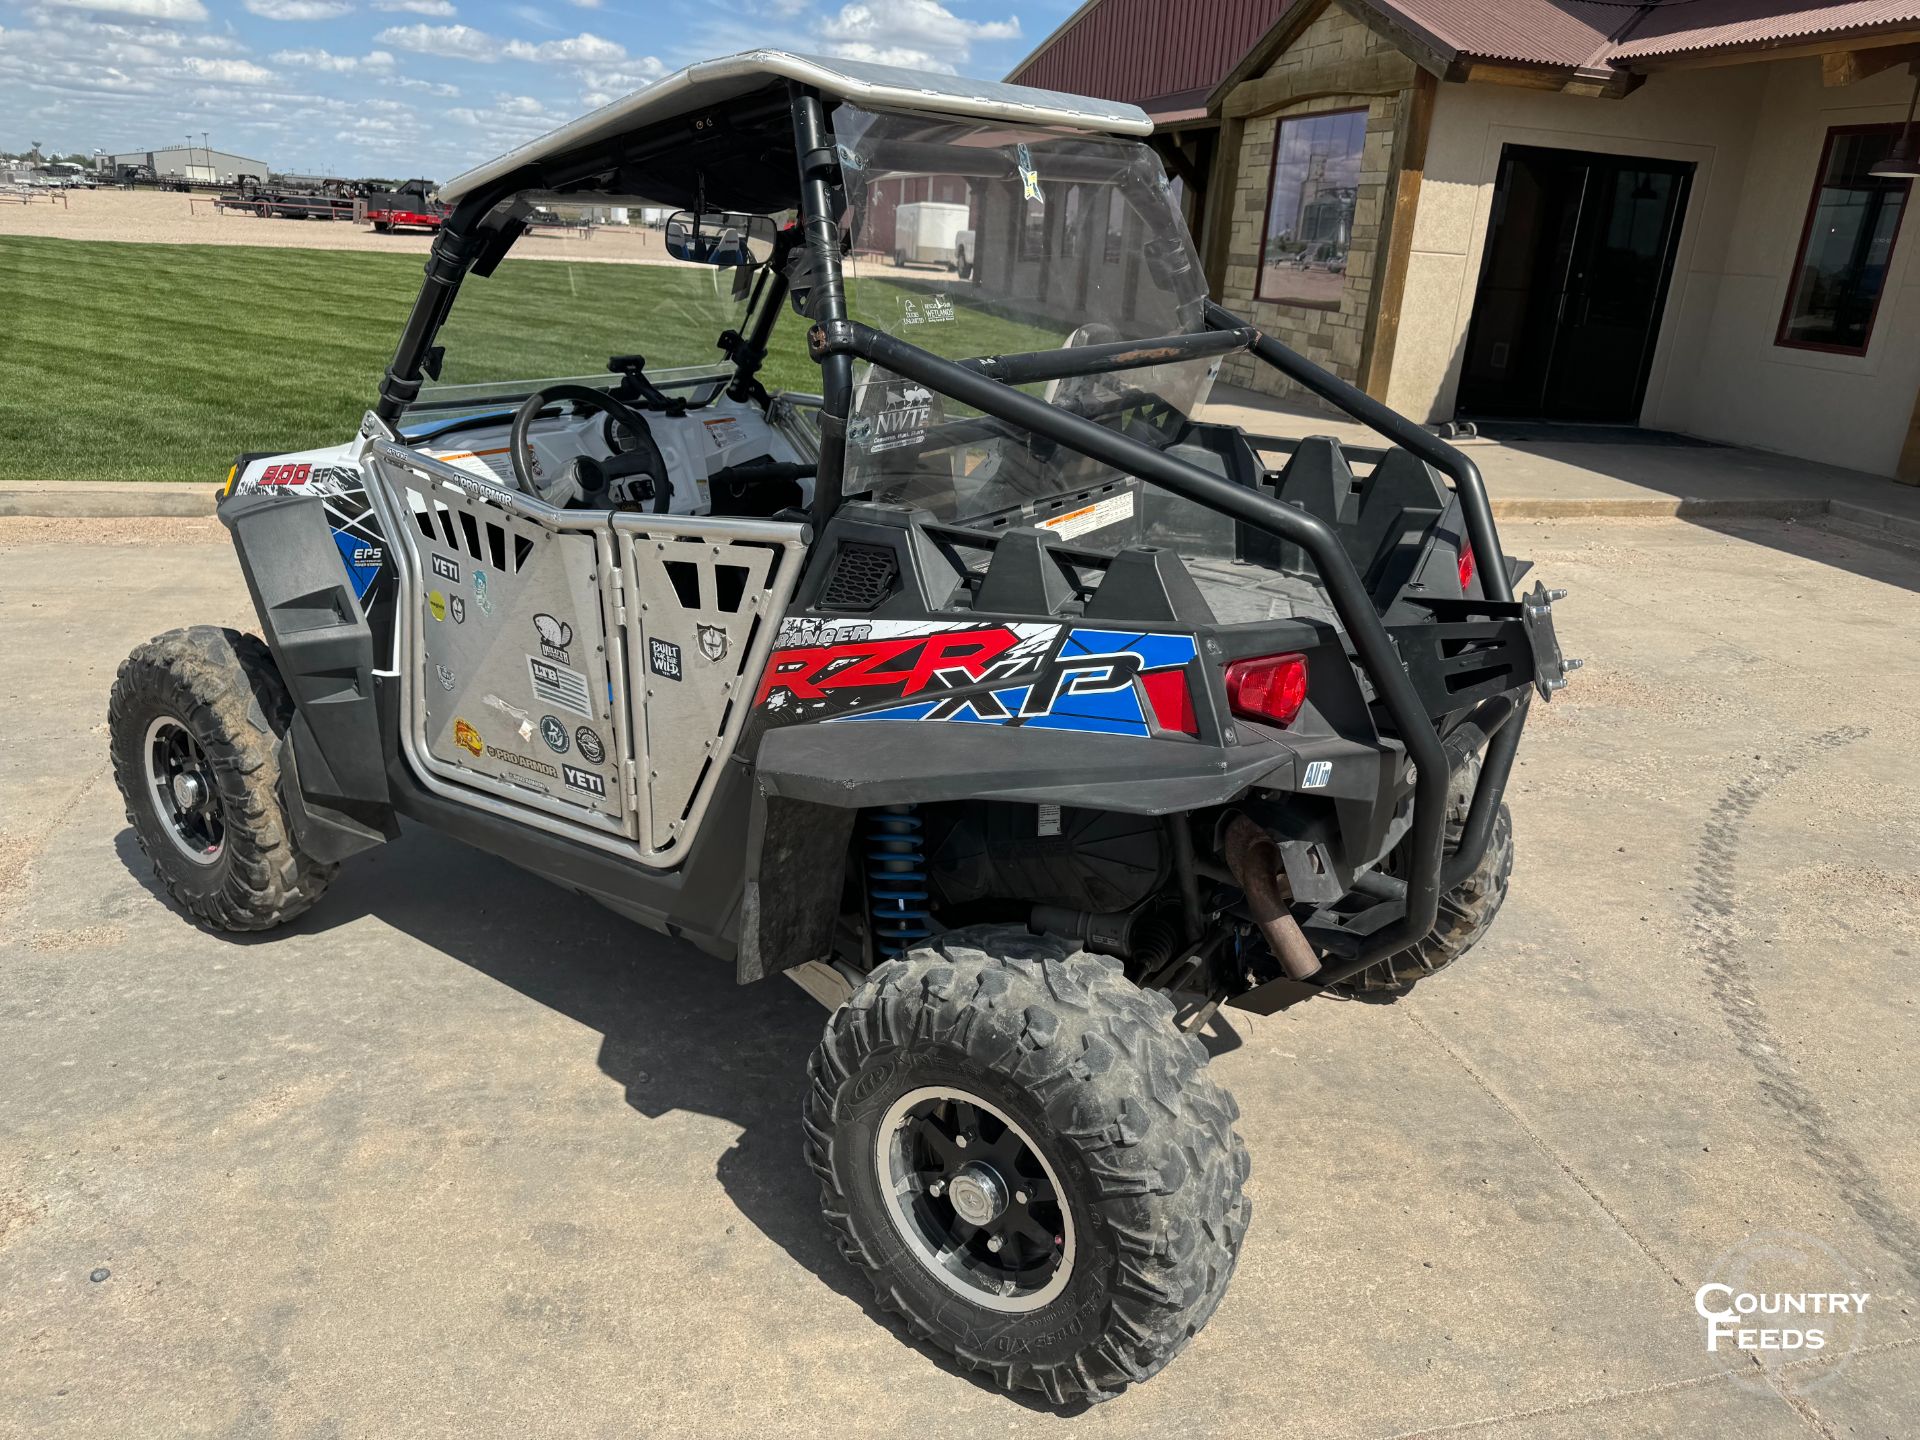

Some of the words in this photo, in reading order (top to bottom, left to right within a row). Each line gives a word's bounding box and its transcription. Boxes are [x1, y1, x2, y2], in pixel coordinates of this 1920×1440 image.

[258, 464, 313, 485] 900
[311, 467, 335, 483] EFI
[460, 477, 479, 494] PRO
[479, 485, 513, 506] ARMOR
[354, 548, 383, 559] EPS
[433, 556, 458, 580] YETI
[651, 641, 678, 657] BUILT
[775, 624, 873, 649] RANGER
[754, 628, 1019, 709] RZR
[921, 652, 1145, 722] XP
[496, 748, 518, 764] PRO
[519, 756, 558, 778] ARMOR
[1303, 763, 1322, 787] All
[564, 767, 603, 793] YETI
